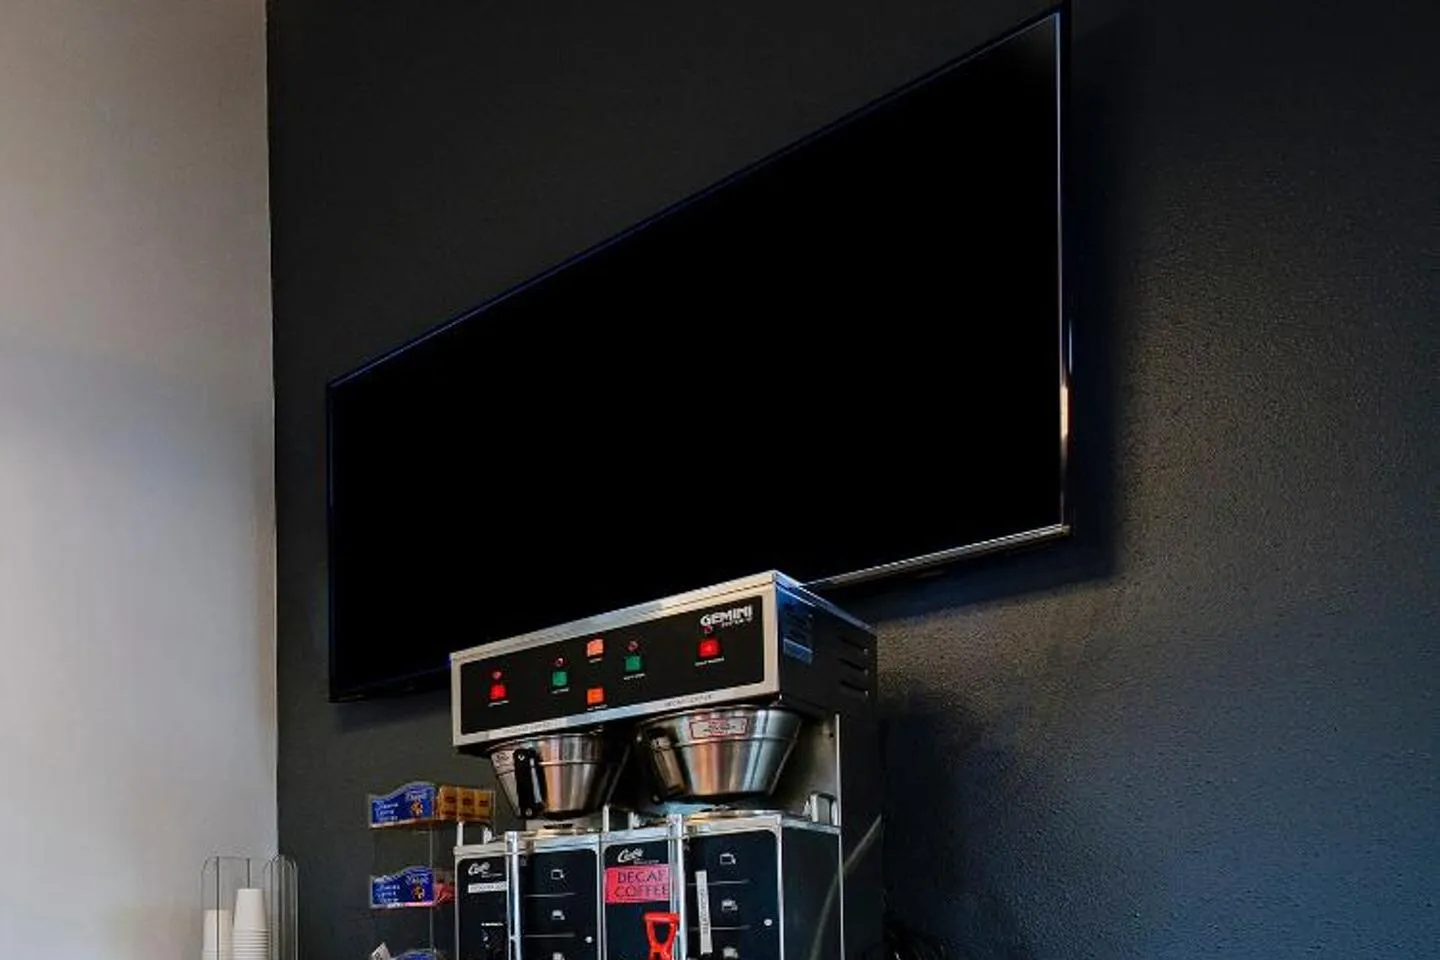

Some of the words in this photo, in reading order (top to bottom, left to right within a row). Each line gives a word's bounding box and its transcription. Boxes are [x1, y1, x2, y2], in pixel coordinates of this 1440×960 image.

[700, 605, 752, 626] GEMINI
[617, 871, 665, 884] DECAF
[613, 885, 669, 898] COFFEE
